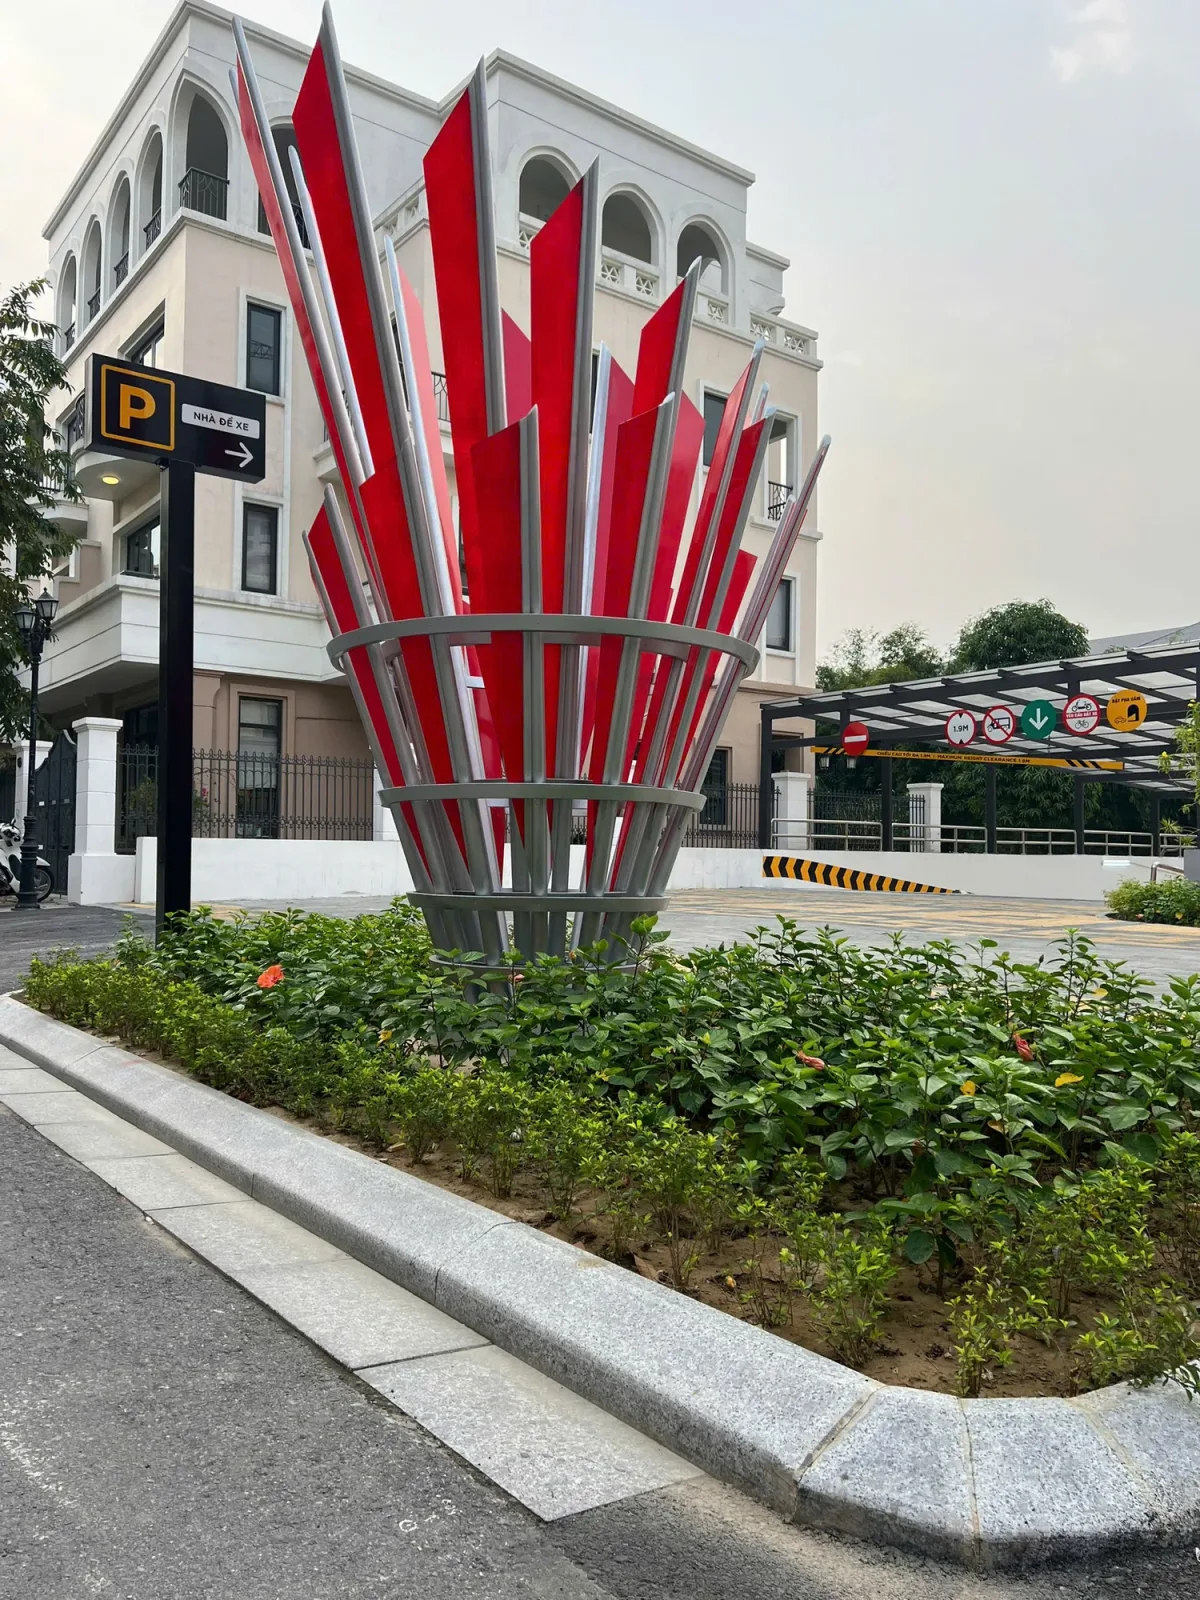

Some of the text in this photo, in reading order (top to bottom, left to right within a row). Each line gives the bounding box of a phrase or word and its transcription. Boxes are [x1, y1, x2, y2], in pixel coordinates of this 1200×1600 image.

[119, 383, 156, 430] P
[193, 411, 249, 431] NHÀ ĐỂ XE
[953, 724, 969, 733] 1.9M
